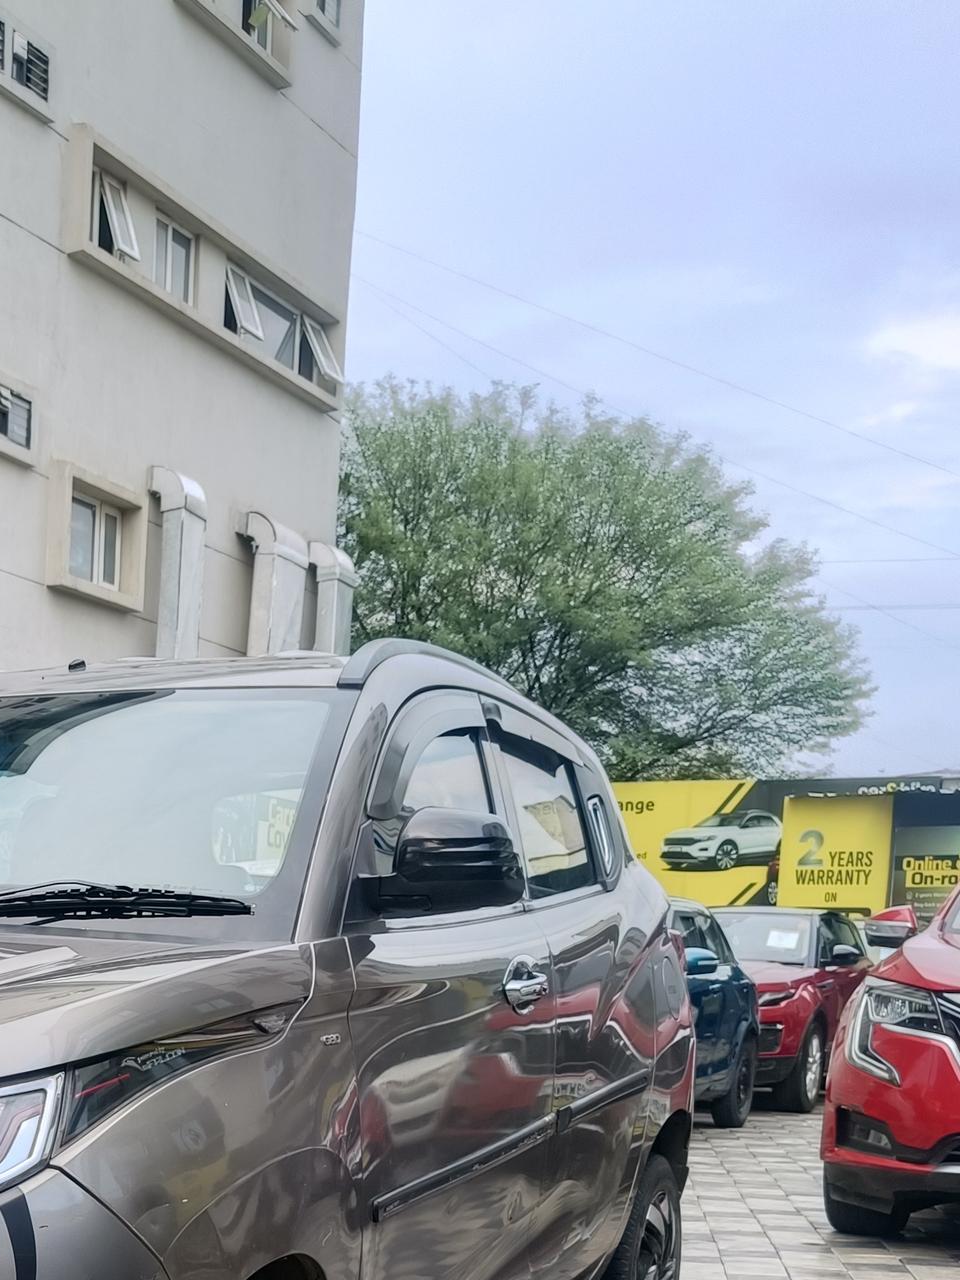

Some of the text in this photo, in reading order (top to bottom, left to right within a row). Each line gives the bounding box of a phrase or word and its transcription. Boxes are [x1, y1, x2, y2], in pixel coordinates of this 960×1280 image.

[617, 800, 655, 815] ange
[797, 829, 873, 868] 2 YEARS
[902, 856, 952, 871] Online
[796, 869, 872, 886] WARRANTY
[911, 872, 959, 885] On-ro
[825, 892, 837, 903] ON
